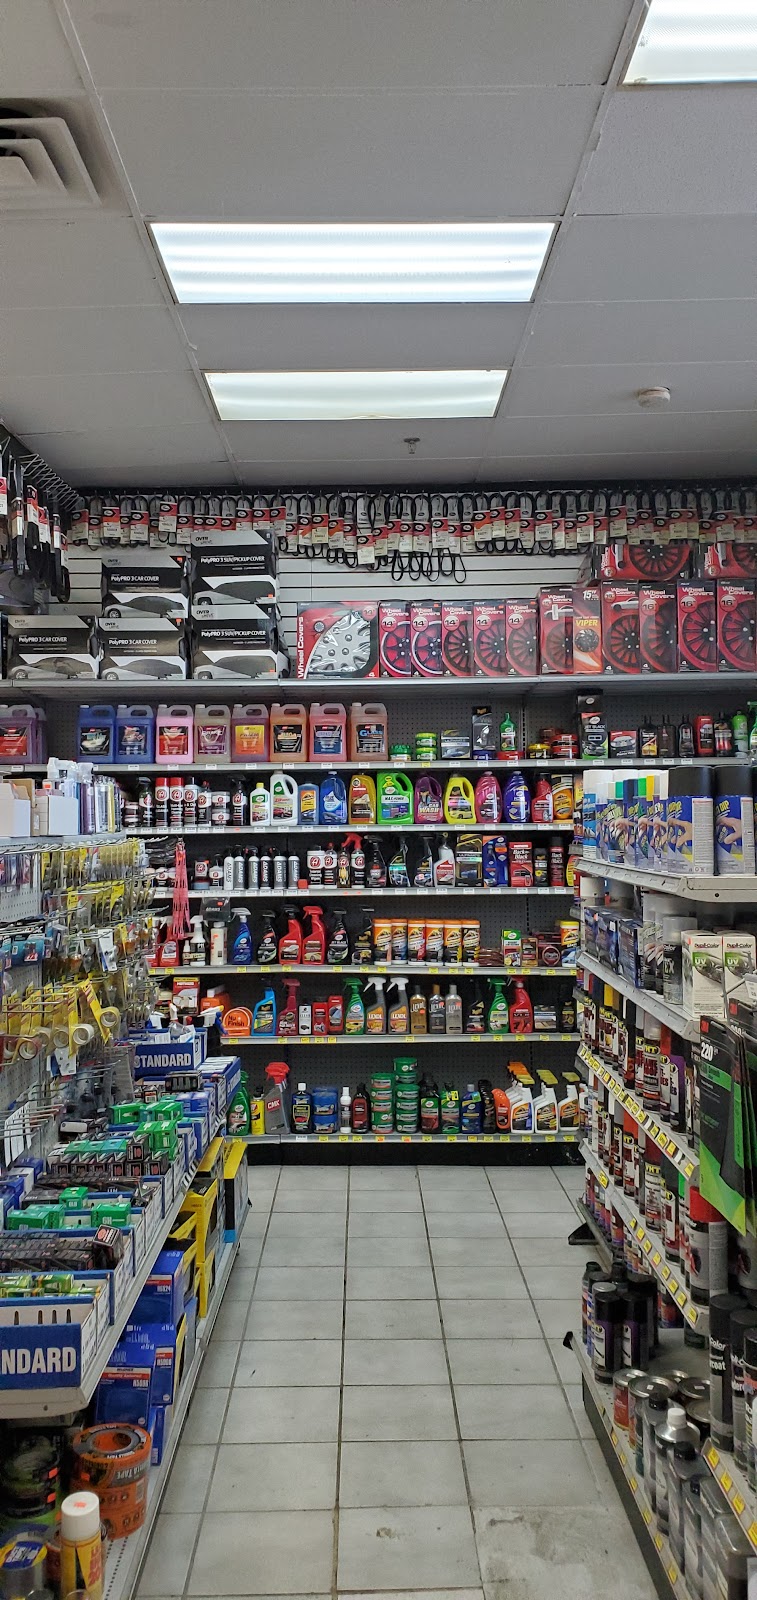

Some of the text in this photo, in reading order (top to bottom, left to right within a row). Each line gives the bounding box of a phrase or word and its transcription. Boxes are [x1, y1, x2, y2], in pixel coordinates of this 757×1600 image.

[695, 957, 706, 965] UV
[727, 957, 739, 965] UV
[701, 1042, 713, 1061] 220
[134, 1053, 192, 1068] STANDARD
[267, 1100, 280, 1109] CMX
[116, 1468, 132, 1480] TAPE
